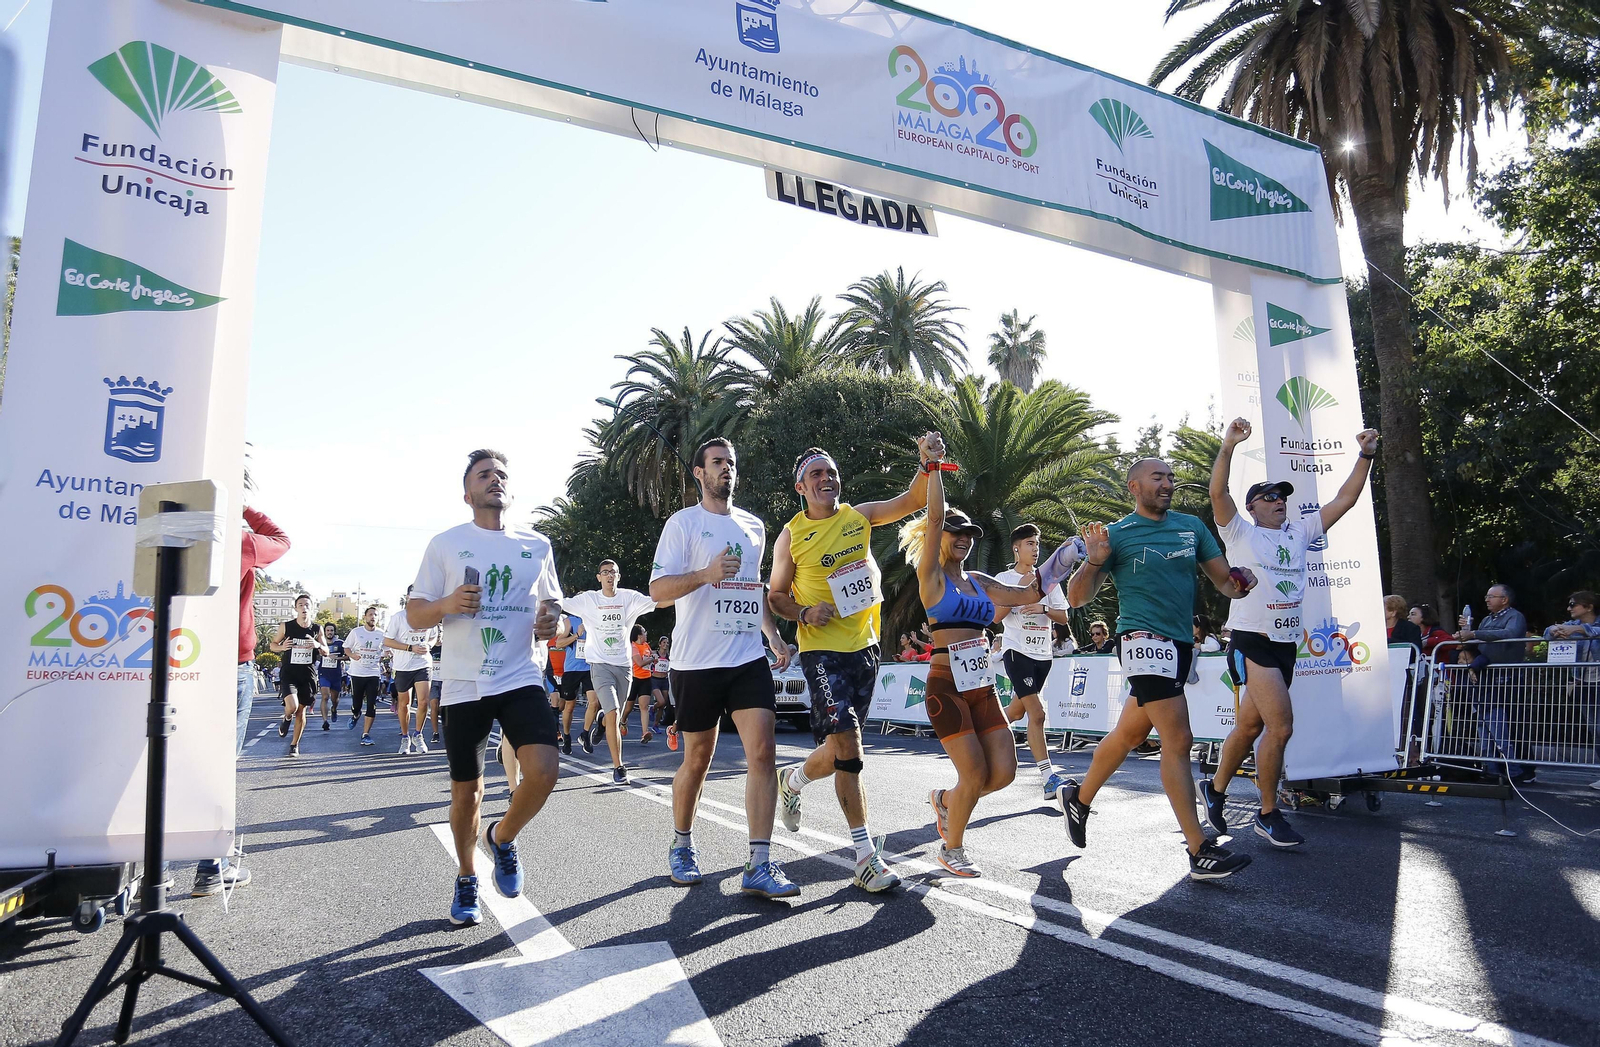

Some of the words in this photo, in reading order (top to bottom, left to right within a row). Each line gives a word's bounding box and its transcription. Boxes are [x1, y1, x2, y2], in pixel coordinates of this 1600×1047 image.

[694, 47, 819, 98] Ayuntamiento
[711, 80, 733, 98] de
[739, 84, 804, 118] Málaga
[888, 45, 1038, 158] 2020
[897, 111, 974, 144] MÁLAGA
[81, 132, 234, 181] Fundación
[898, 129, 953, 152] EUROPEAN
[957, 145, 994, 163] CAPITAL
[996, 155, 1010, 166] OF
[1012, 159, 1040, 175] SPORT
[1096, 158, 1157, 190] Fundación
[101, 174, 210, 217] Unicaja
[1108, 181, 1149, 210] Unicaja
[1211, 166, 1225, 188] El
[1226, 171, 1255, 195] Corte
[1254, 177, 1294, 208] Inglés
[775, 170, 929, 235] LLEGADA
[64, 267, 85, 287] El
[85, 273, 130, 294] Corte
[131, 274, 195, 306] Inglés
[1277, 319, 1296, 331] Corte
[1280, 436, 1343, 451] Fundación
[1290, 459, 1333, 476] Unicaja
[36, 468, 145, 497] Ayunta
[58, 500, 92, 521] de
[1306, 559, 1361, 572] tamiento
[841, 576, 872, 598] 1385
[1308, 576, 1351, 589] Málaga
[602, 613, 622, 622] 2460
[714, 599, 759, 615] 17820
[952, 597, 994, 623] NIKE
[1274, 615, 1300, 629] 6469
[949, 644, 959, 652] 41
[1025, 635, 1046, 646] 9477
[28, 646, 121, 669] MÁLAGA
[1126, 646, 1174, 661] 18066
[960, 655, 989, 674] 1386
[1295, 668, 1323, 677] EUROPEAN
[26, 670, 94, 681] EUROPEAN
[98, 671, 146, 681] CAPITAL
[168, 672, 201, 681] SPORT
[1058, 701, 1097, 710] Ayuntamiento
[1068, 710, 1090, 719] Málaga
